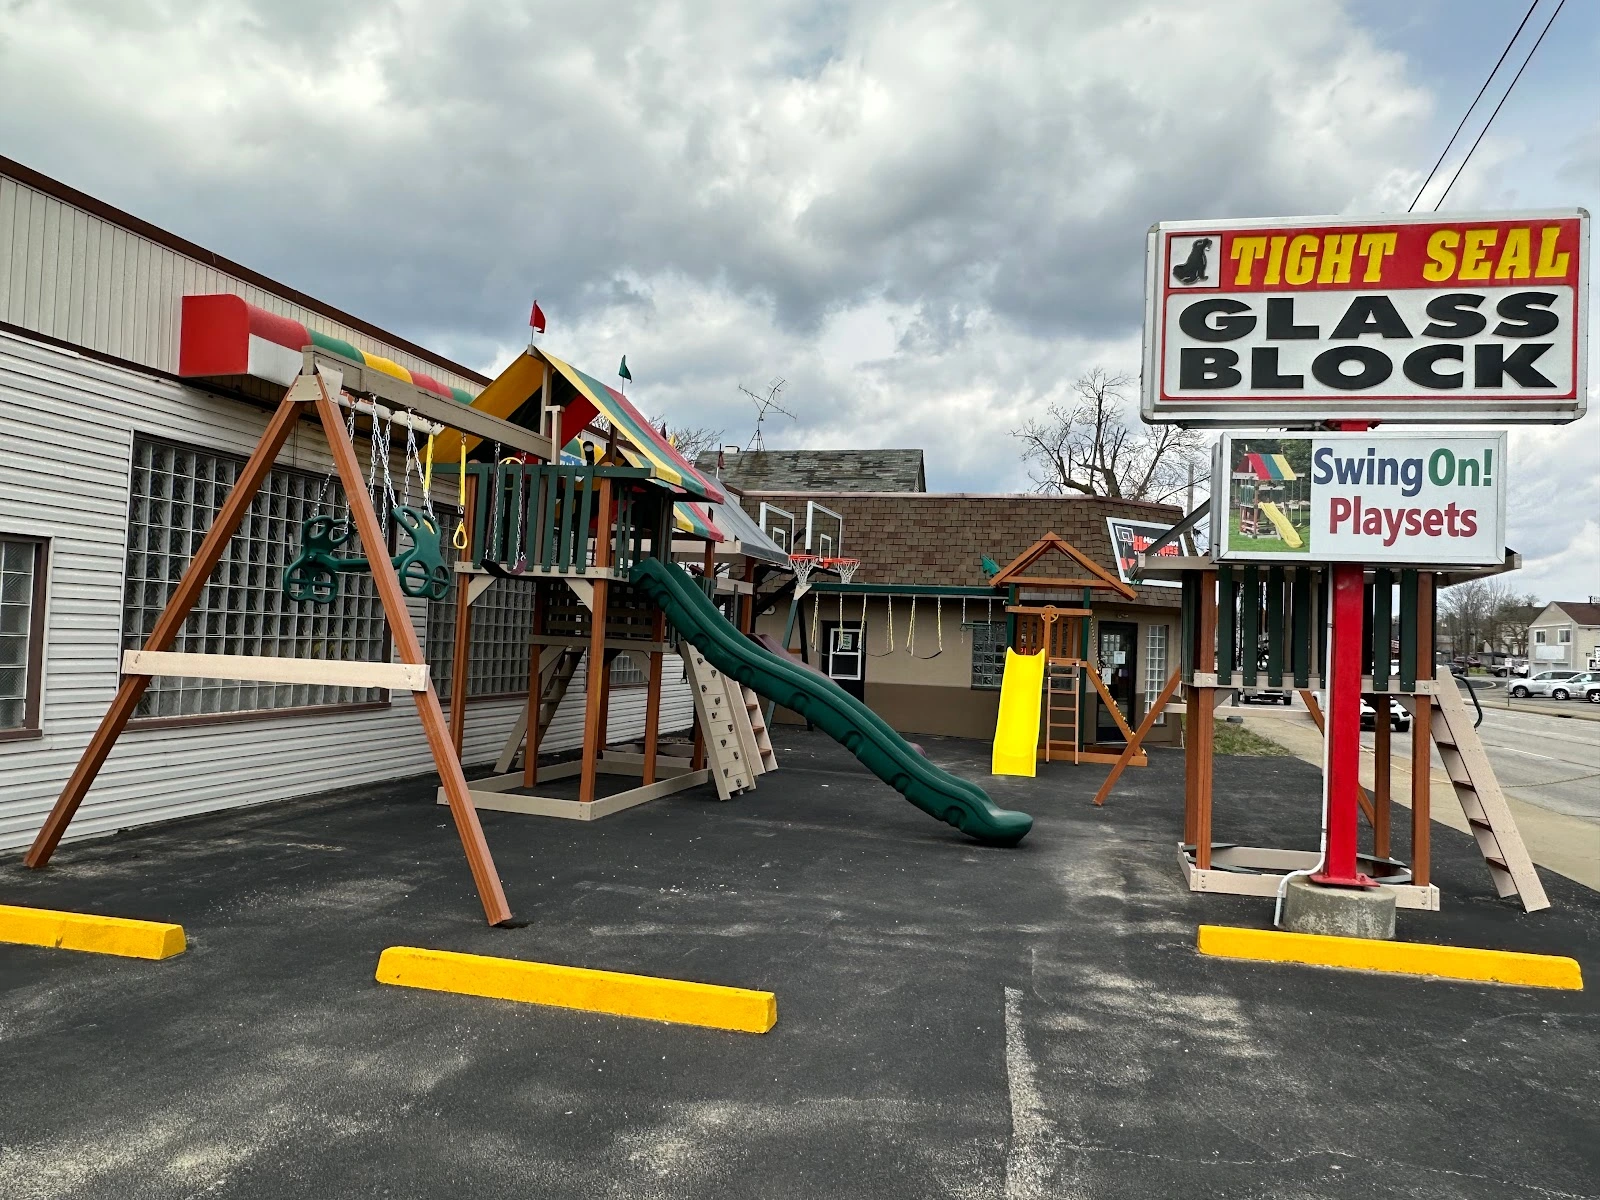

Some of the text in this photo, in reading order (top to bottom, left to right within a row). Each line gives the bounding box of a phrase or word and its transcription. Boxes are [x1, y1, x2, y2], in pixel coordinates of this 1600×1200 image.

[1230, 227, 1570, 286] TIGHT SEAL
[1179, 291, 1560, 342] GLASS
[1179, 343, 1558, 390] BLOCK
[1329, 496, 1478, 547] Playsets
